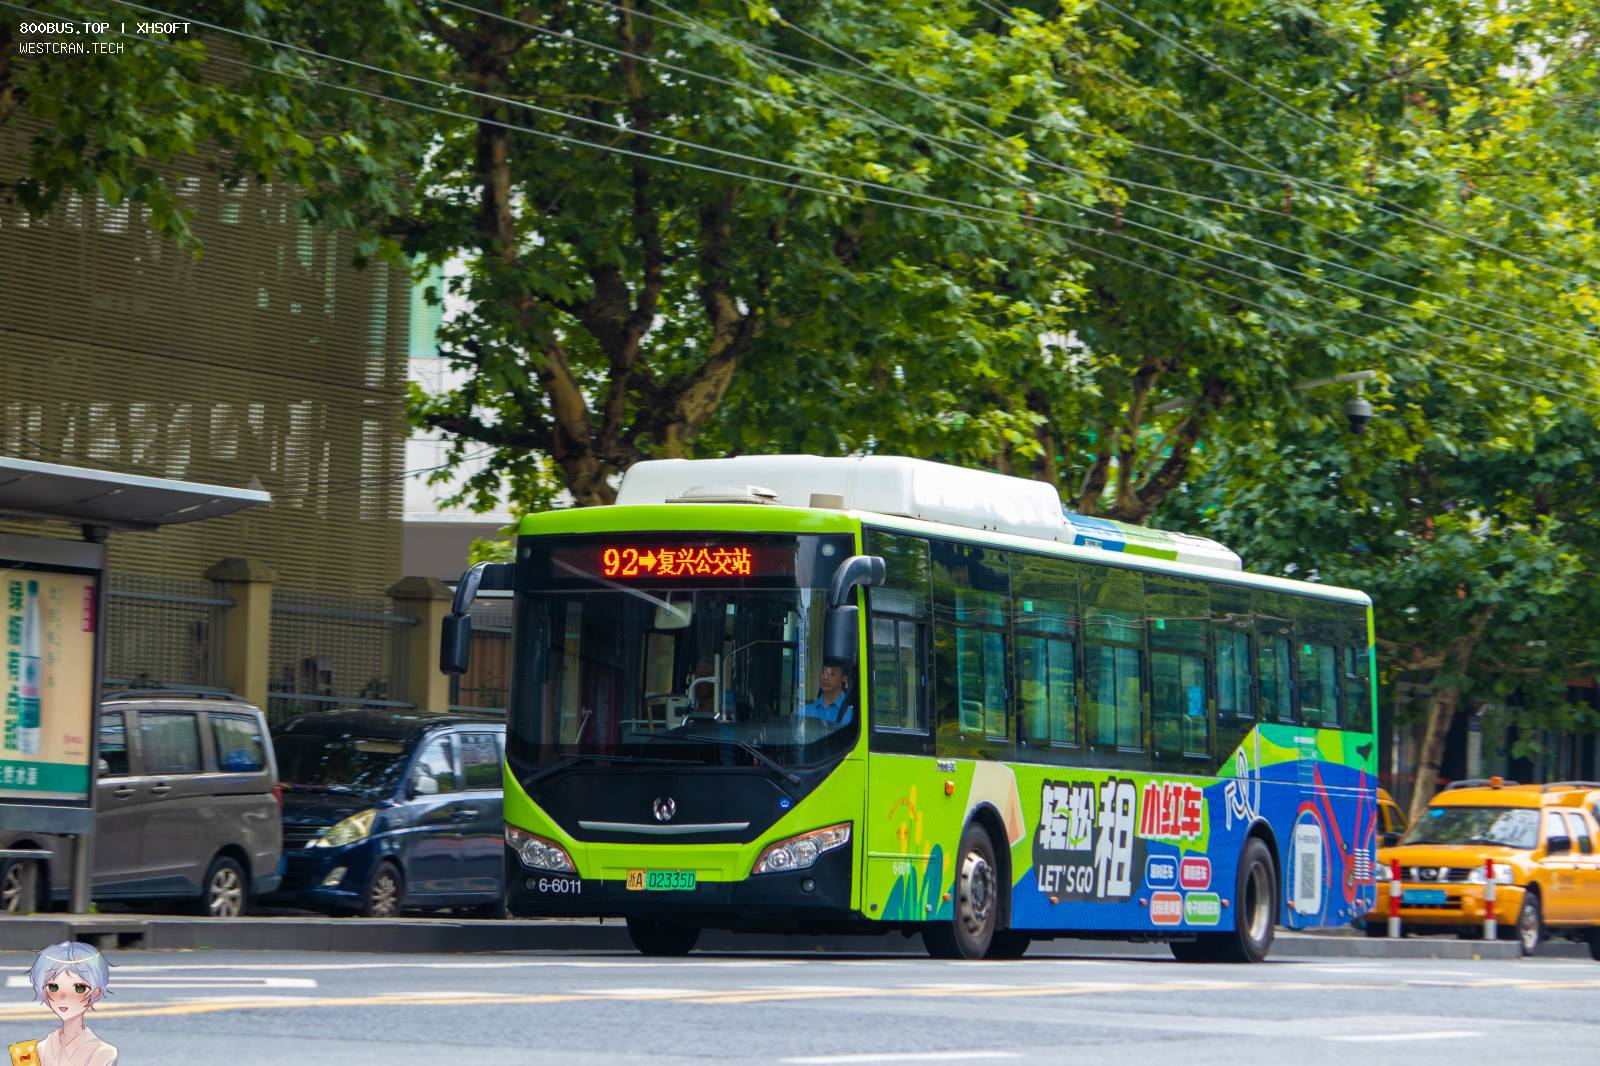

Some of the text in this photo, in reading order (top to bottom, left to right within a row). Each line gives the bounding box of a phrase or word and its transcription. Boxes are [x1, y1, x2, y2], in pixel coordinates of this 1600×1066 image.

[603, 548, 752, 575] 92 复兴公交站
[1140, 781, 1203, 840] 小红车
[538, 878, 581, 894] 6-6011
[1038, 864, 1094, 893] LET'S GO
